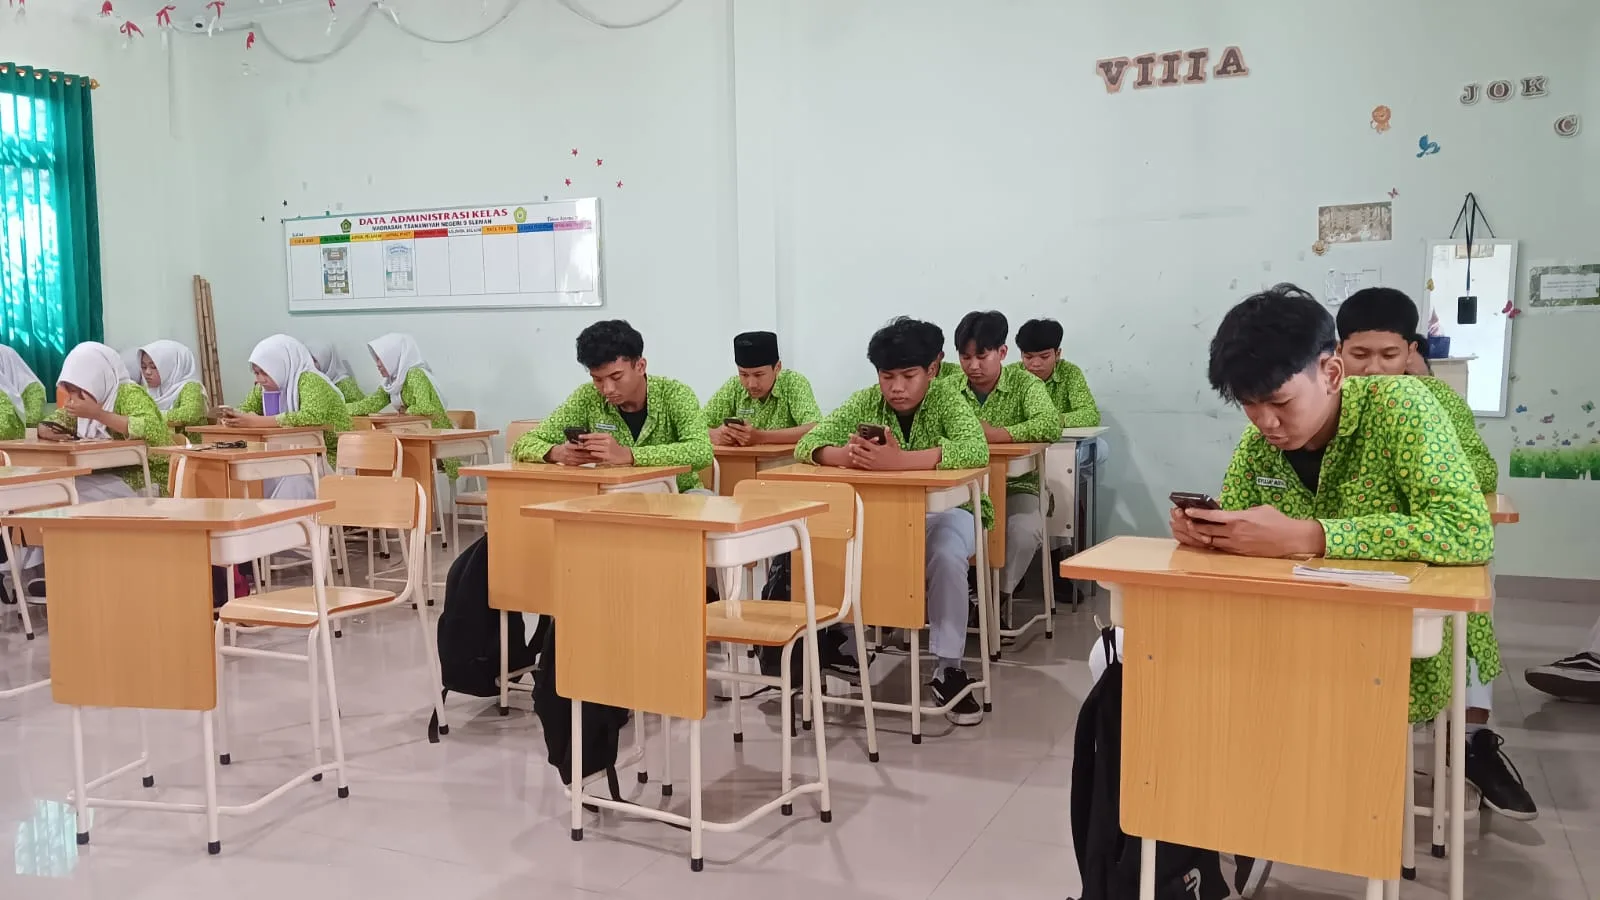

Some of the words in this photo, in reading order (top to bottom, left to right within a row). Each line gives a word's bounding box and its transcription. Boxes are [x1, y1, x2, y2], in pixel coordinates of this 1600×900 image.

[1554, 115, 1578, 137] C
[359, 216, 386, 226] DATA
[390, 211, 470, 224] ADMINISTRASI
[472, 208, 508, 219] KELAS
[372, 223, 402, 231] MADRASAH
[404, 220, 440, 230] TSANAWIYAH
[441, 219, 462, 228] NEGERI
[468, 218, 492, 226] SLEMAN
